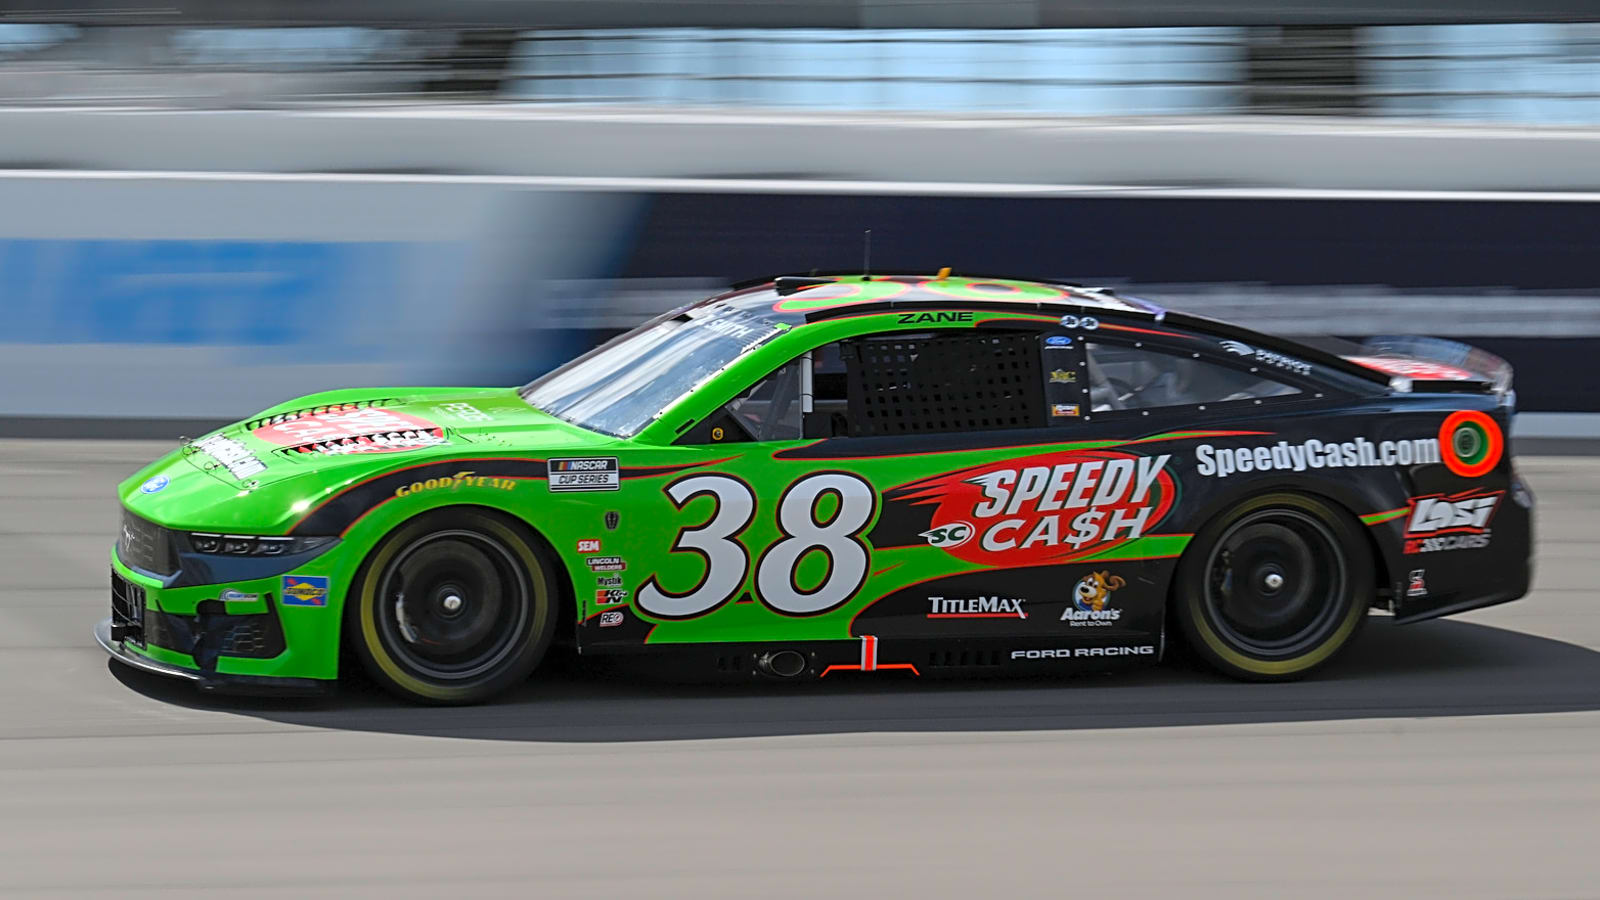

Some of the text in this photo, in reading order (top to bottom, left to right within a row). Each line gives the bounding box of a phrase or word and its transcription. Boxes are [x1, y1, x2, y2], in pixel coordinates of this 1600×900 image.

[898, 312, 974, 323] ZANE
[1196, 437, 1440, 477] SpeedyCash.com
[571, 461, 608, 470] NASCAR
[395, 472, 516, 498] GOODYEAR
[558, 474, 609, 485] CUP SERIES
[962, 454, 1172, 518] SPEEDY
[930, 526, 967, 544] SC
[578, 541, 600, 552] SEM
[632, 469, 878, 621] 38
[587, 557, 620, 565] LINCOLN
[1060, 607, 1121, 621] Aaron's
[1010, 646, 1155, 660] FORD RACING
